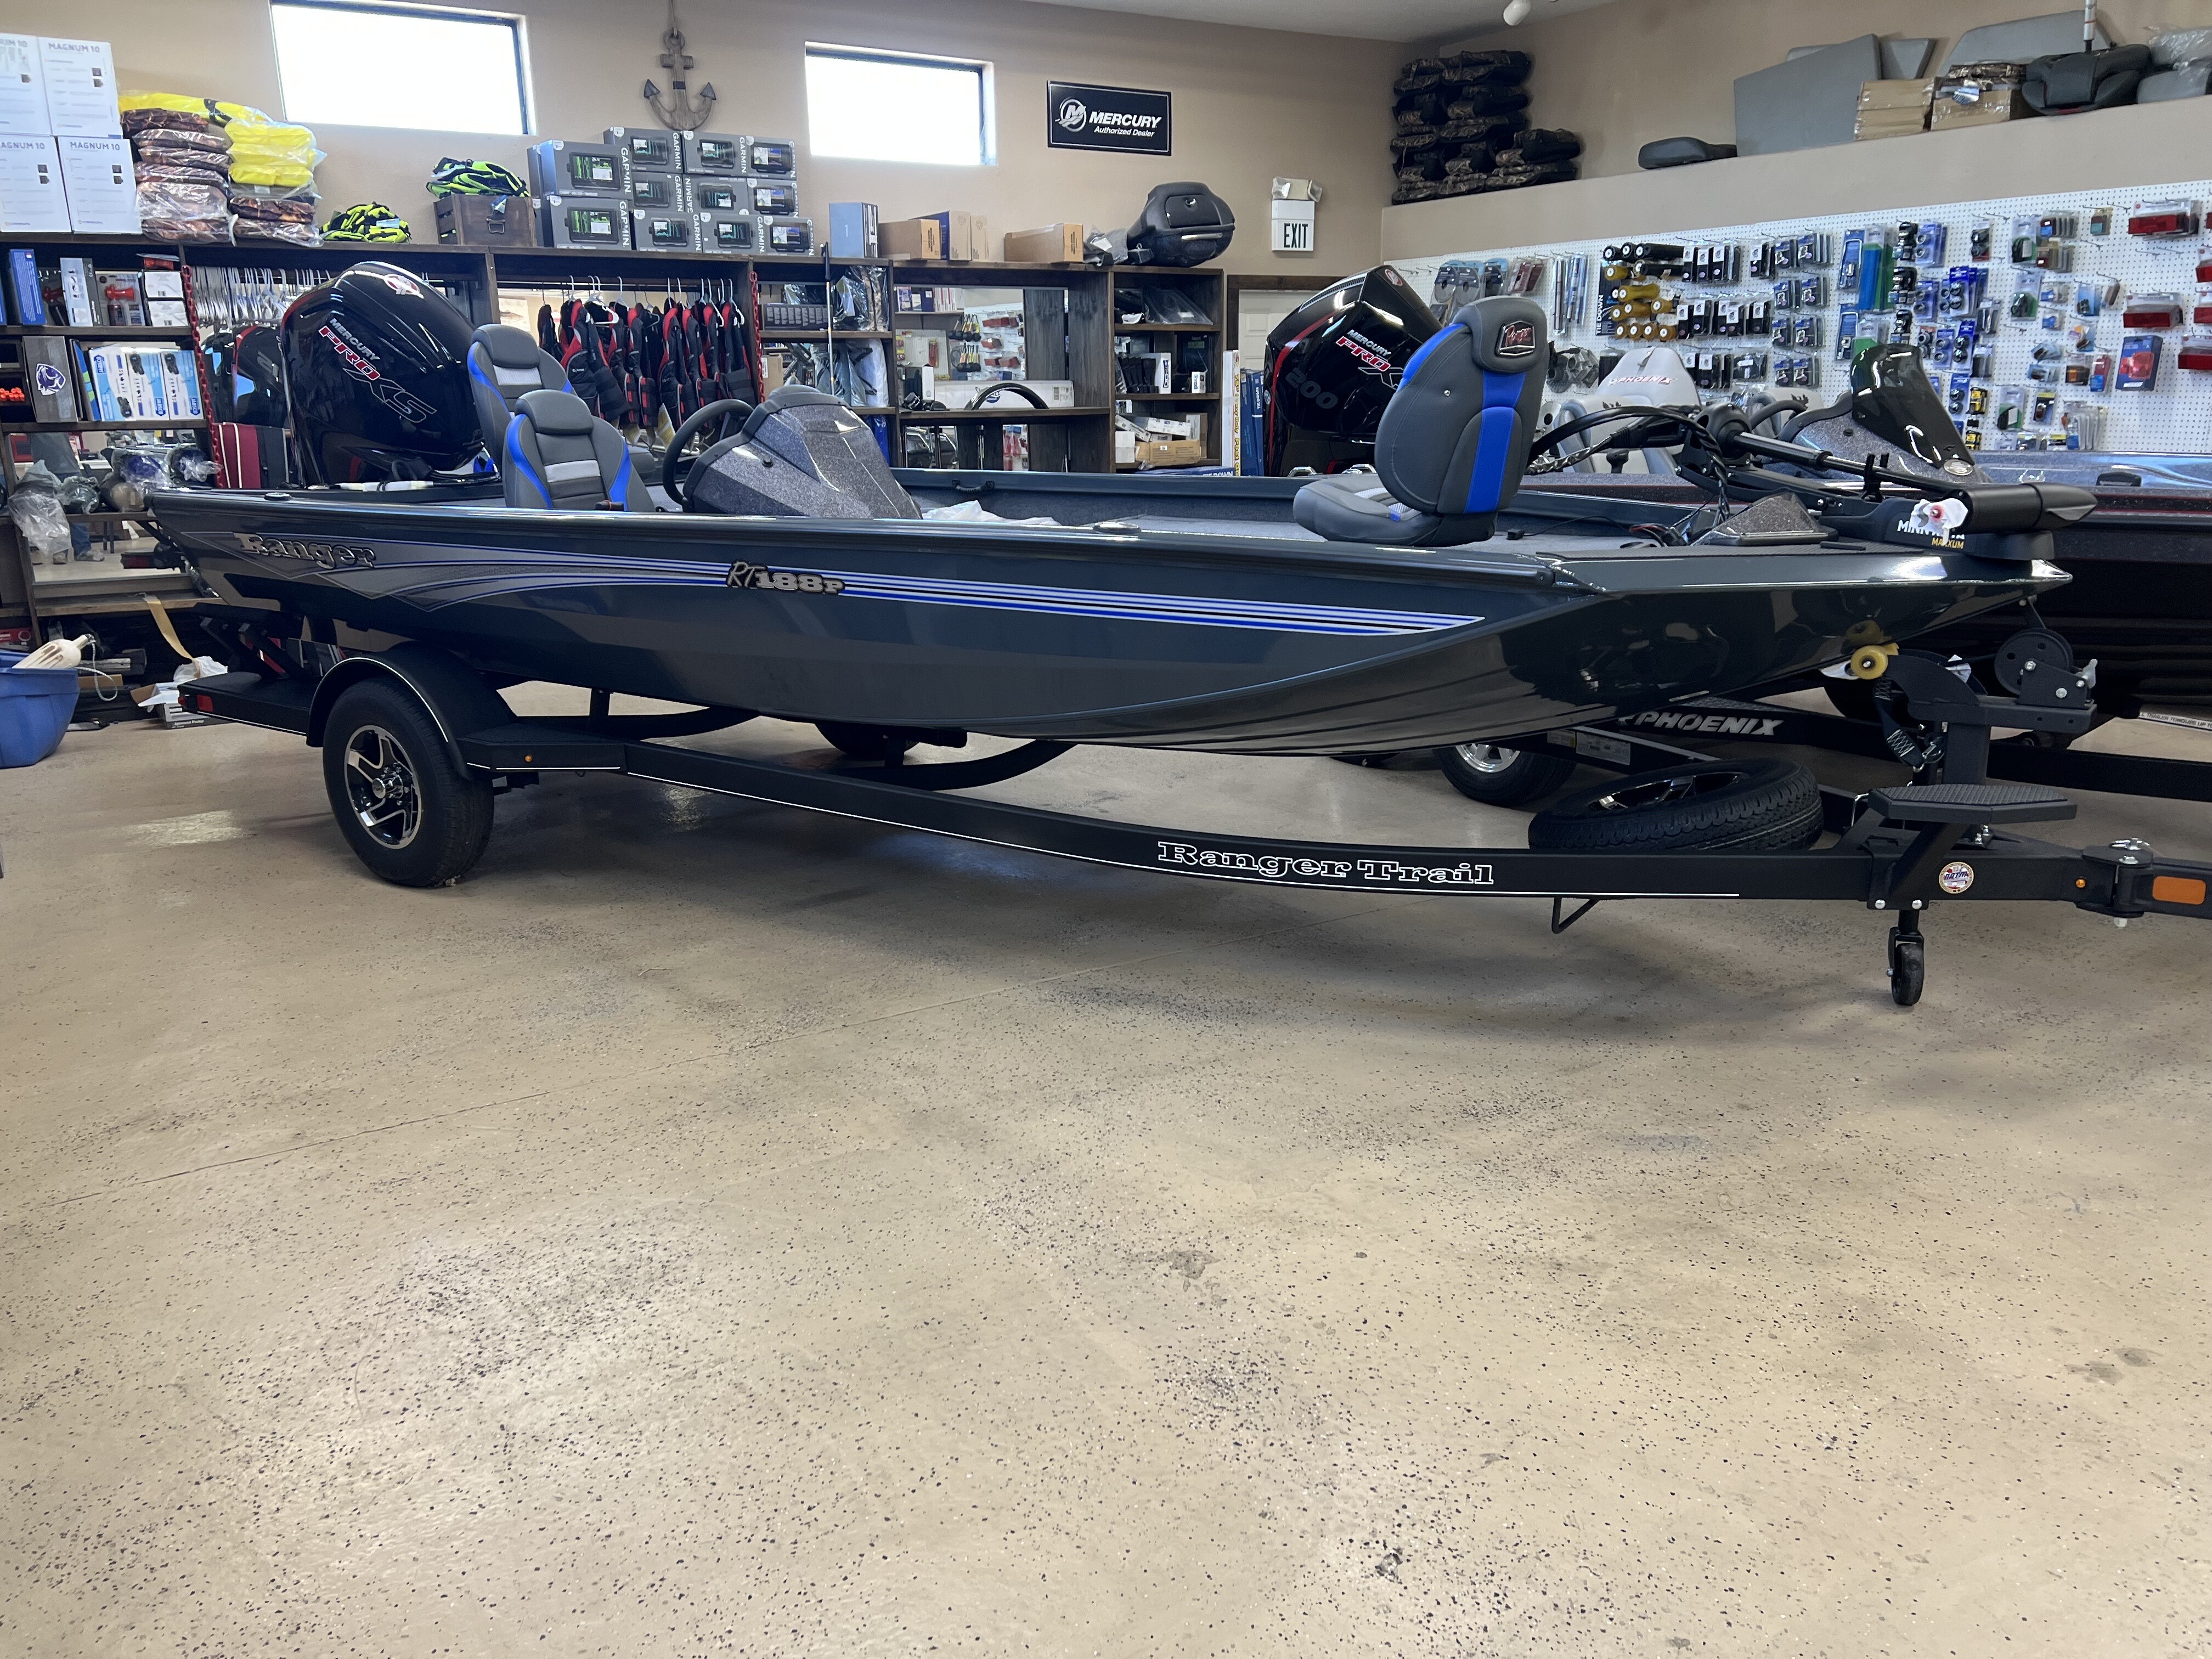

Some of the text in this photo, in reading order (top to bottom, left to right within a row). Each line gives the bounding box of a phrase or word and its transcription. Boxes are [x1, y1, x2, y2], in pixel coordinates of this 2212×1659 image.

[48, 42, 89, 53] MAGNUM
[1088, 111, 1162, 128] MERCURY
[1093, 126, 1155, 137] Authorized Dealer
[70, 141, 109, 150] MAGNUM
[673, 132, 682, 170] GARMIN
[620, 147, 631, 193] GARMIN
[675, 175, 684, 212] GARMIN
[685, 178, 693, 213] GARMIN
[619, 201, 630, 246] GARMIN
[693, 214, 702, 251] GARMIN
[757, 216, 765, 253] GARMIN
[1283, 223, 1309, 249] EXIT
[319, 325, 381, 381] PRO
[330, 318, 381, 362] MERCURY
[1335, 336, 1391, 372] PRO
[1347, 329, 1392, 357] MERCURY
[1285, 367, 1339, 409] 200
[1617, 376, 1677, 386] PHOENIX
[234, 532, 376, 569] Ranger
[1932, 538, 1964, 549] MAXUM
[1634, 711, 1785, 736] PHOENIX
[1158, 841, 1494, 885] Ranger Trail
